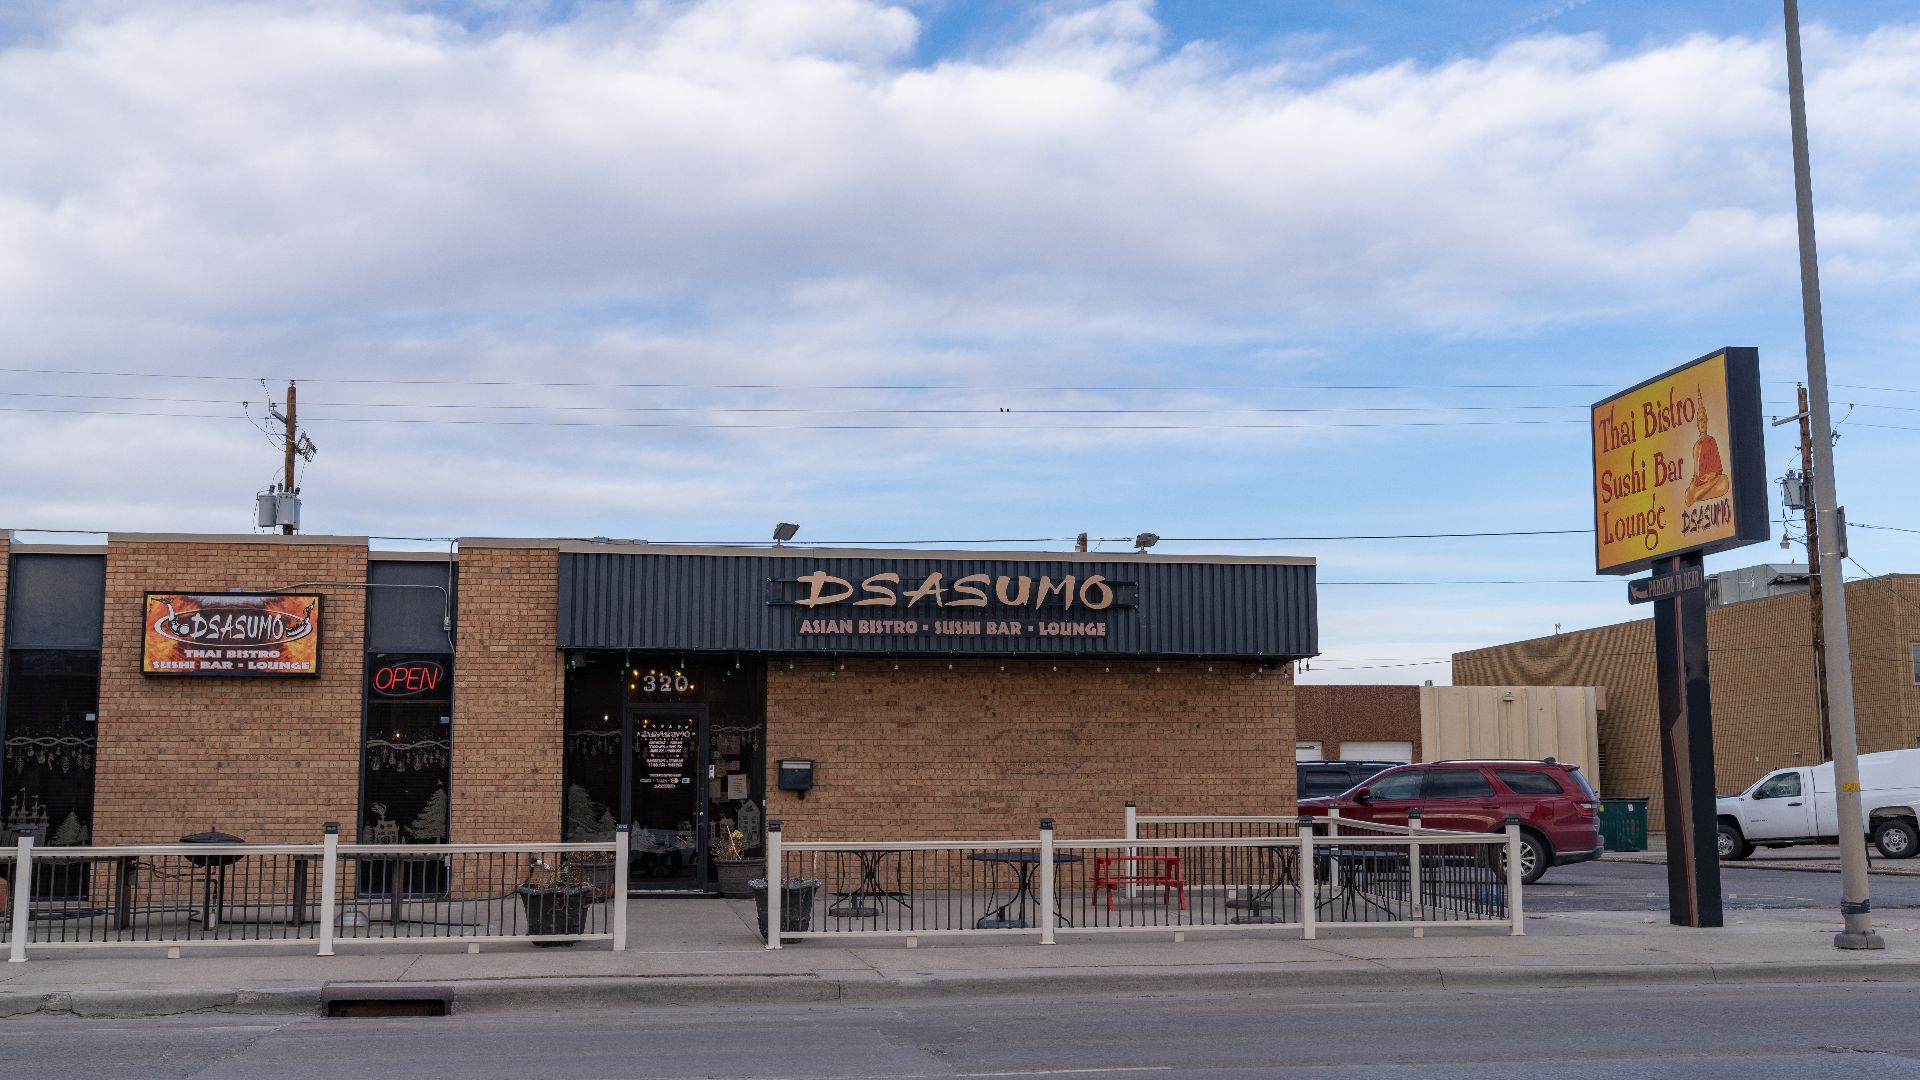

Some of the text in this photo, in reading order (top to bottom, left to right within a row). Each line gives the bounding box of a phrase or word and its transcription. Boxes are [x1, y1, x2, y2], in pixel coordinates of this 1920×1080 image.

[1600, 386, 1695, 453] Thai Bistro
[1601, 450, 1684, 504] Sushi Bar
[1603, 493, 1666, 550] Lounge
[795, 570, 1114, 611] DSASUMO
[1648, 576, 1675, 597] PARKING
[189, 612, 284, 641] DSASUMO
[800, 619, 1106, 637] ASIAN BISTRO SUSHI BAR LOUNGE
[152, 660, 311, 671] SUSHI BAR LOUNGE
[184, 649, 281, 659] THAI BISTRO
[375, 666, 440, 691] OPEN
[643, 675, 689, 692] 320
